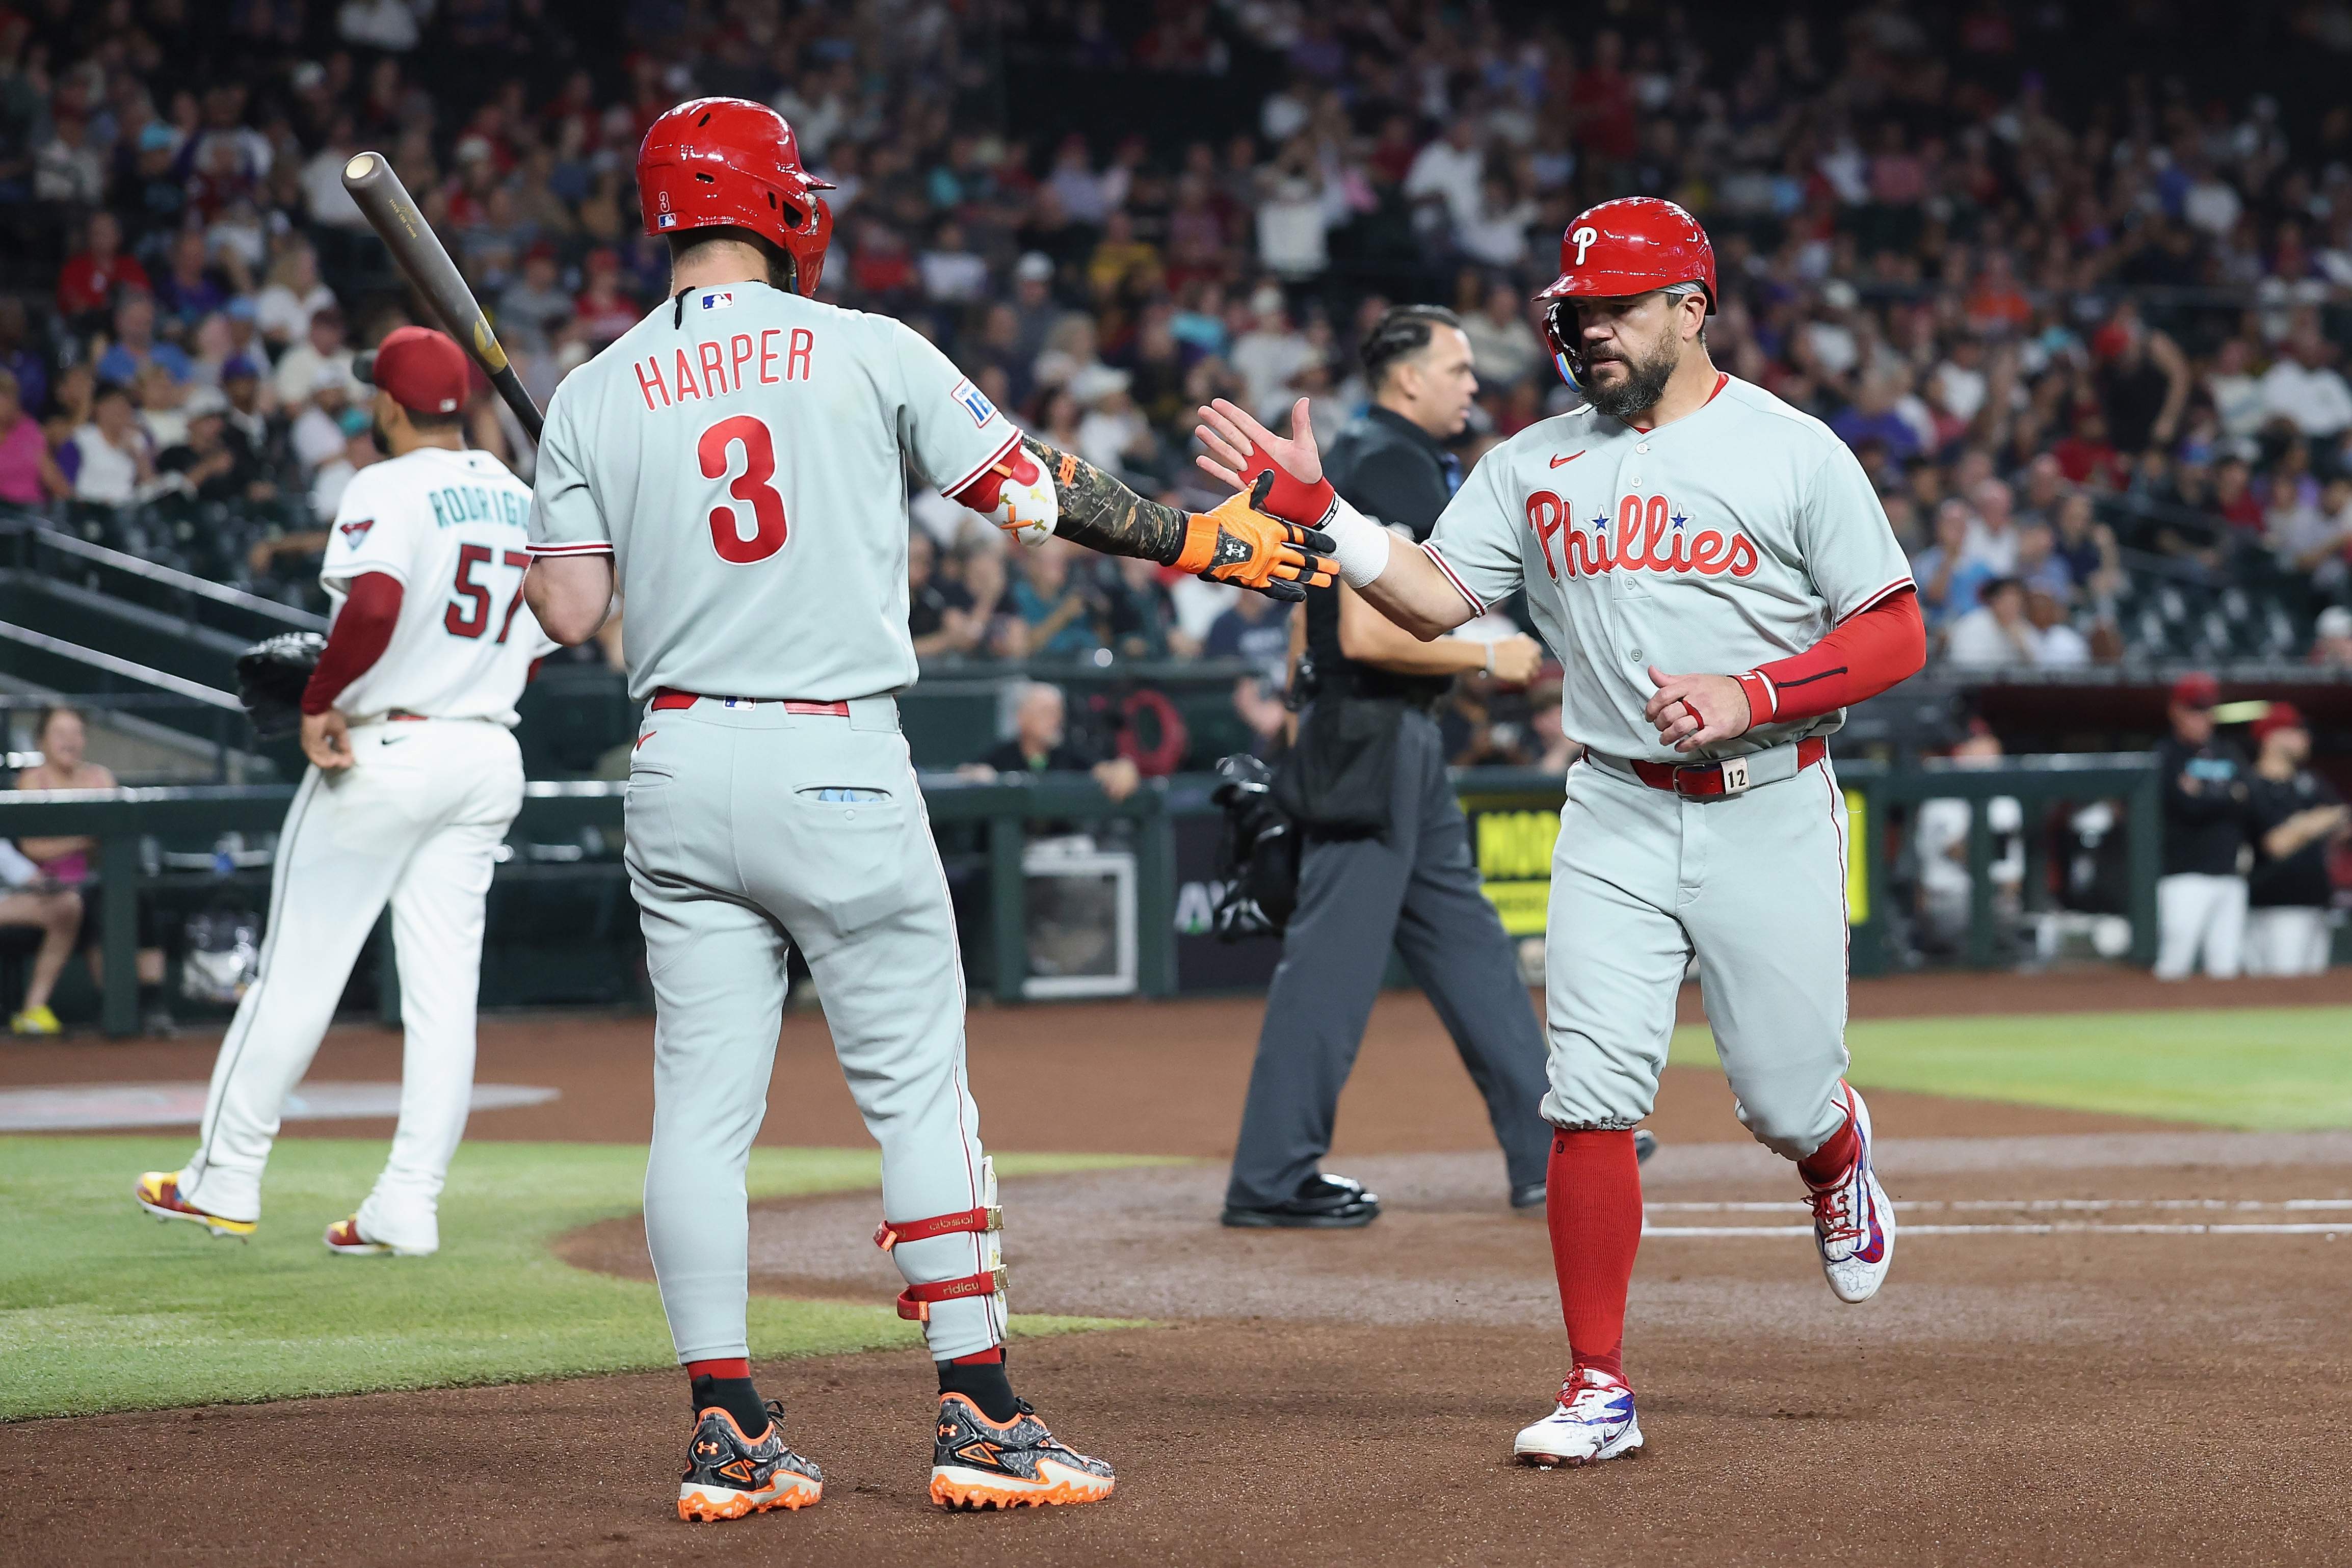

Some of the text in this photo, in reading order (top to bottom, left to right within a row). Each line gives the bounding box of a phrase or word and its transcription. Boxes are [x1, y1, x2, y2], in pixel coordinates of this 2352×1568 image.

[658, 191, 670, 212] 3
[1572, 227, 1597, 265] P
[634, 327, 814, 412] HARPER
[697, 412, 790, 567] 3
[1525, 488, 1760, 584] Phillies
[444, 543, 533, 645] 57
[1728, 769, 1746, 788] 12
